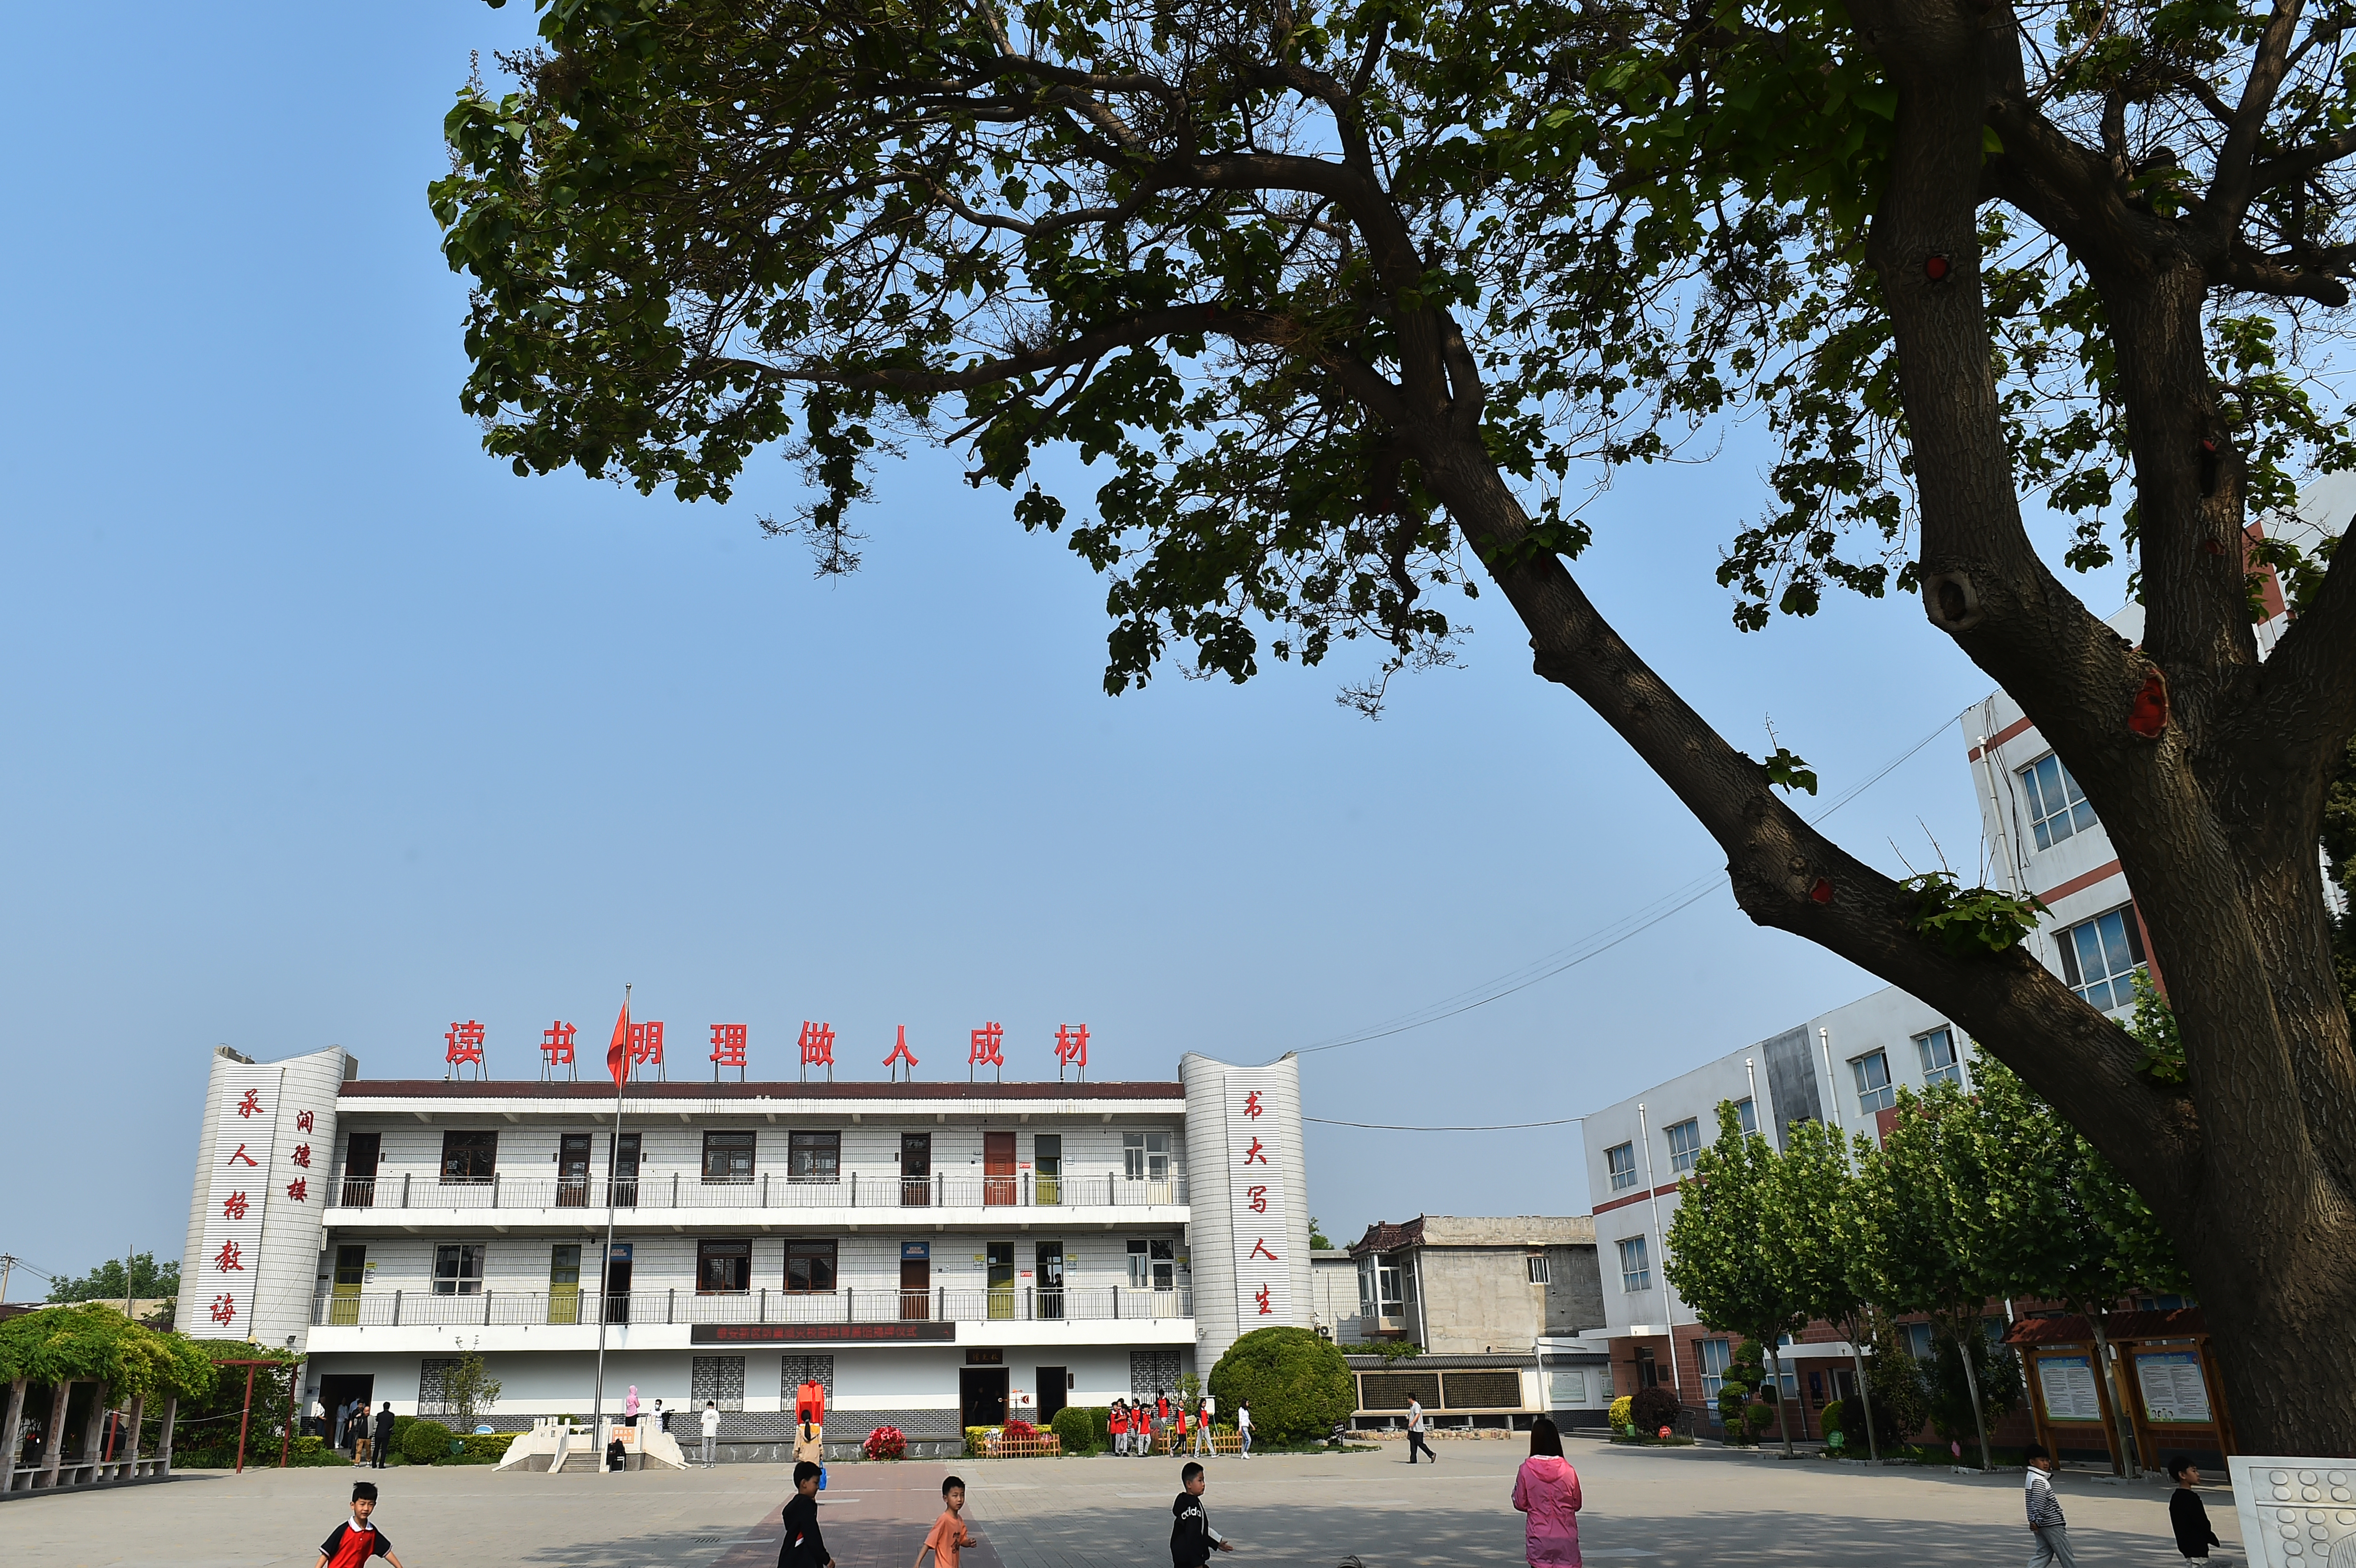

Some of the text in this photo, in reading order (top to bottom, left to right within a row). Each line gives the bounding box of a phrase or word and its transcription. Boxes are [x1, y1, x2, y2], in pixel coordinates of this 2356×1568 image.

[445, 1020, 1091, 1067] 读书明理做人成材
[209, 1088, 264, 1327] 承人格教诲
[1244, 1090, 1278, 1315] 书大写人生
